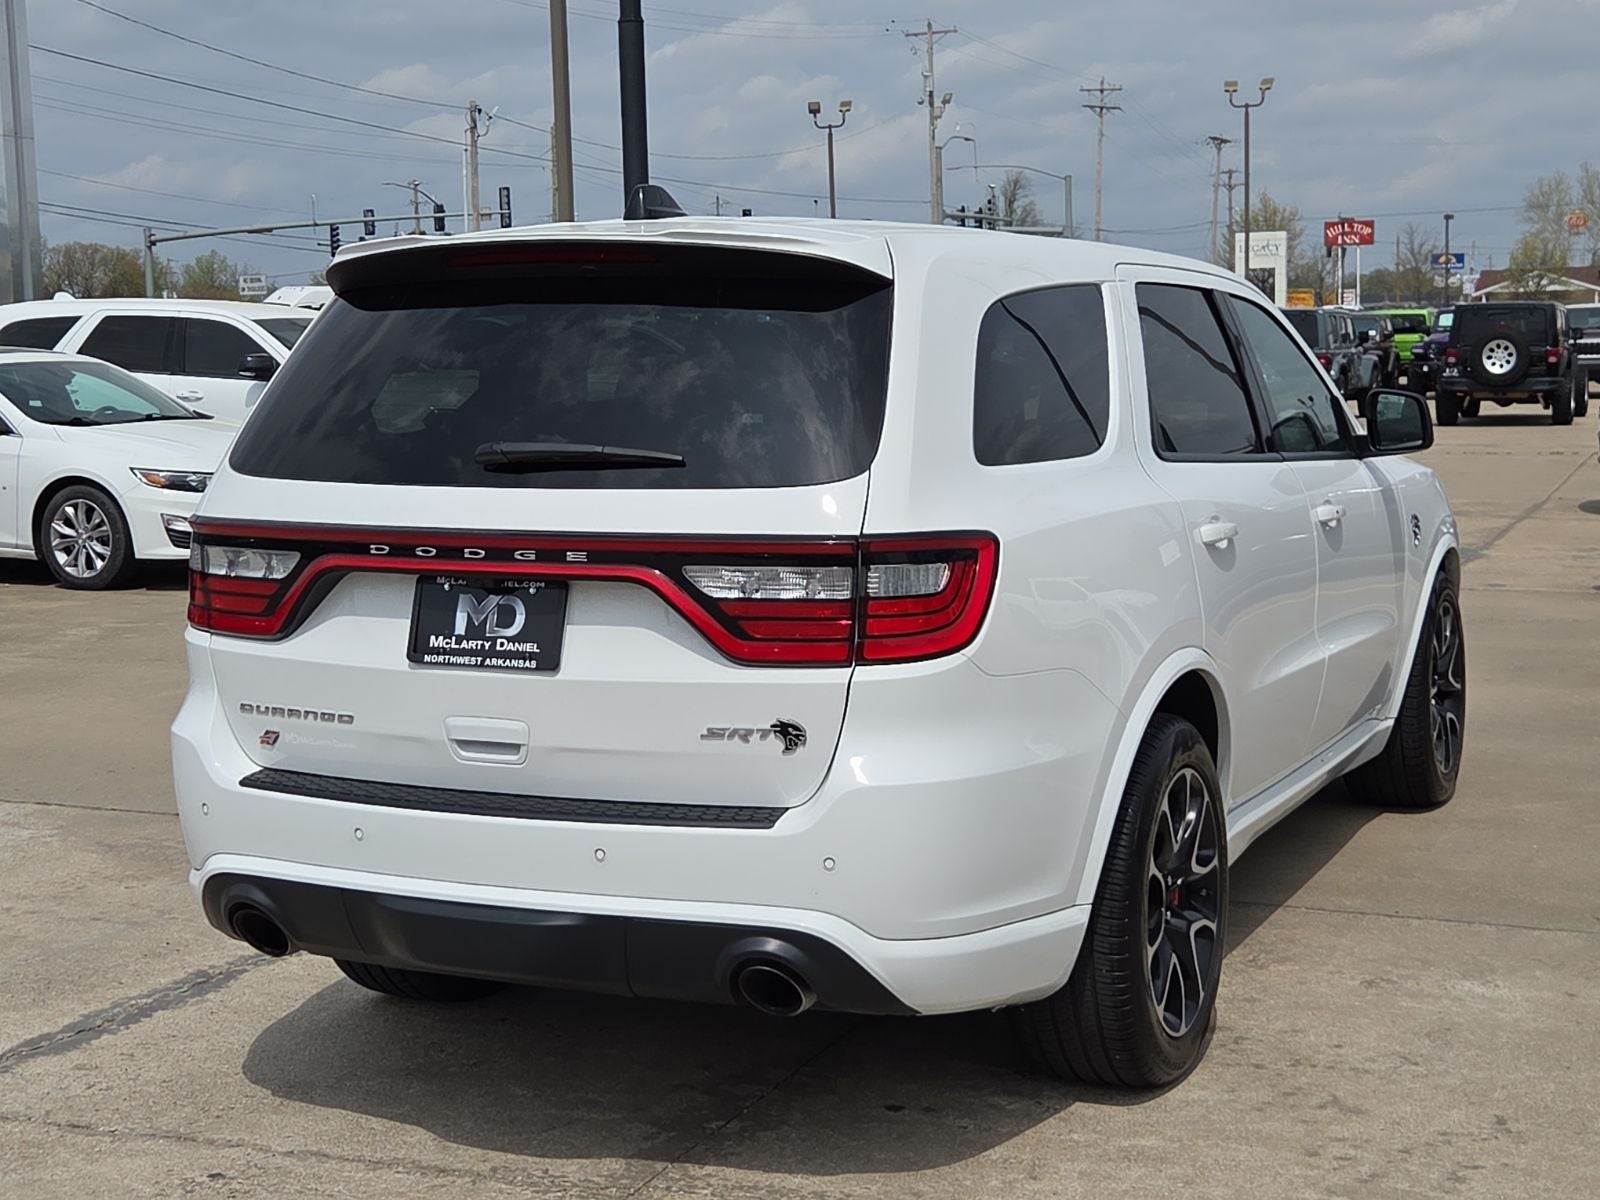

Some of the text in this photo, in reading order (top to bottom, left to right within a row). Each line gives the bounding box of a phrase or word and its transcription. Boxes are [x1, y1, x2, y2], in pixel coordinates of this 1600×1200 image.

[1352, 222, 1372, 235] TOP
[1337, 234, 1360, 244] INN
[369, 544, 588, 562] DODGE
[454, 593, 526, 637] MD
[495, 638, 541, 652] DANIEL
[424, 654, 537, 669] NORTHWEST ARKANSAS
[240, 703, 354, 725] DURANGO
[700, 727, 774, 744] SRT
